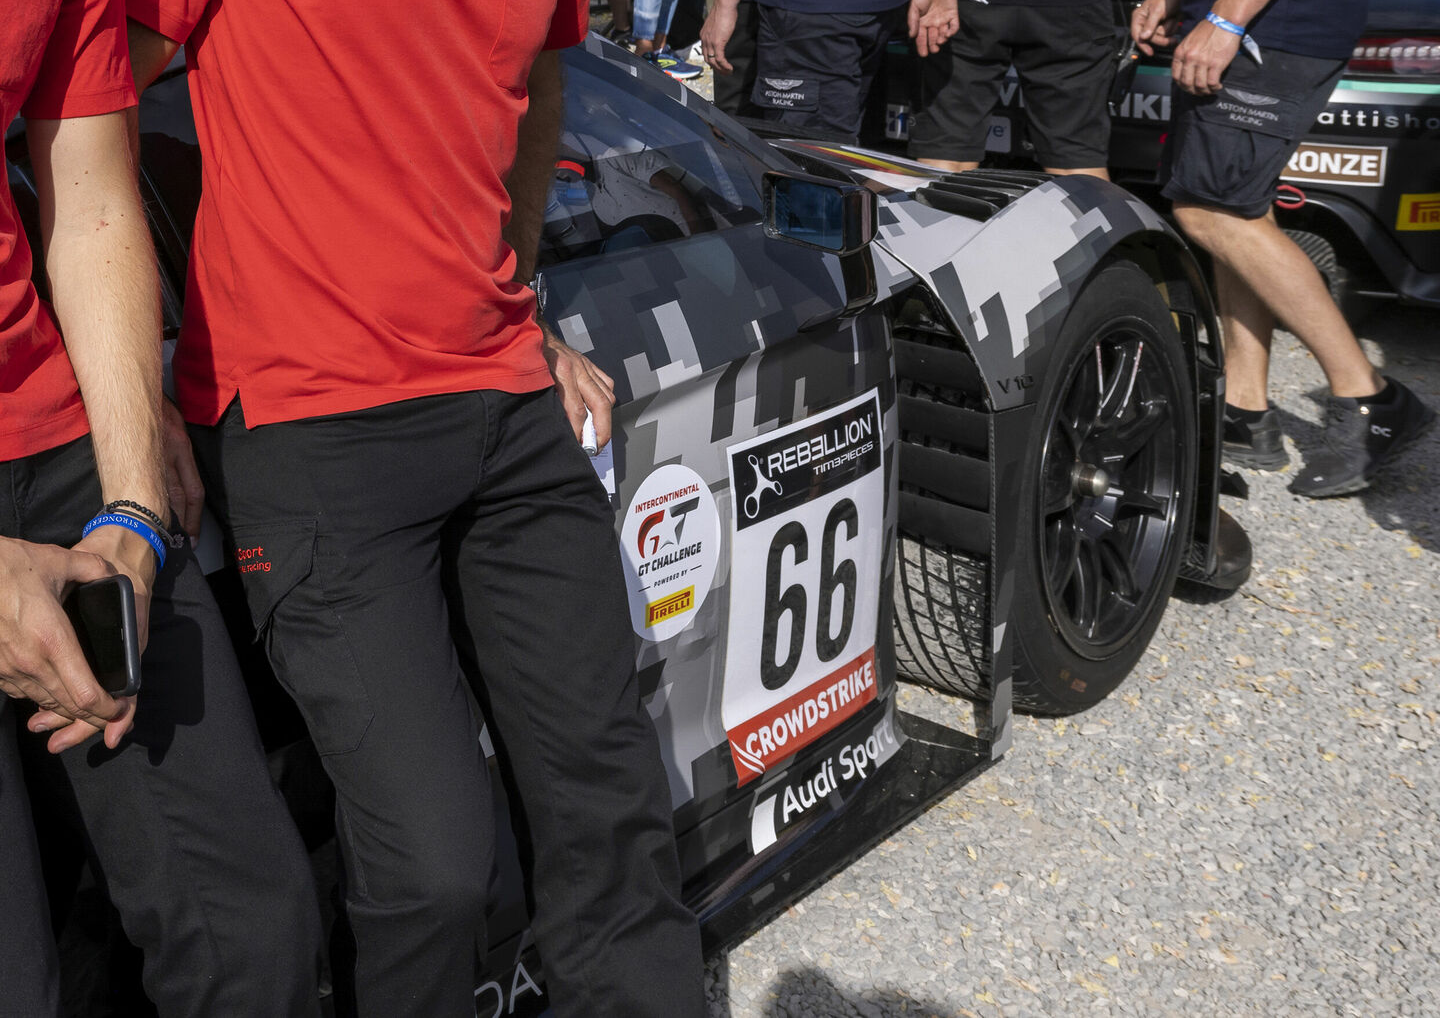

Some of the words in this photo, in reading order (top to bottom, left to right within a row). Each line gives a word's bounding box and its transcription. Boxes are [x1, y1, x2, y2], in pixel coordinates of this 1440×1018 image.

[1217, 101, 1247, 114] ASTON
[1247, 107, 1279, 122] MARTIN
[1229, 113, 1262, 126] RACING
[1317, 109, 1440, 129] attisho
[1287, 150, 1379, 177] RONZE
[767, 414, 872, 478] REBELLION
[813, 441, 874, 475] TIMEPIECES
[635, 483, 700, 514] INTERCONTINENTAL
[638, 561, 651, 577] GT
[651, 541, 702, 572] CHALLENGE
[654, 572, 680, 588] POWERED
[681, 569, 688, 577] BY
[760, 497, 859, 691] 66
[649, 590, 690, 623] PIRELLI
[746, 660, 874, 760] CROWDSTRIKE
[782, 757, 838, 824] Audi
[839, 721, 893, 780] Sport
